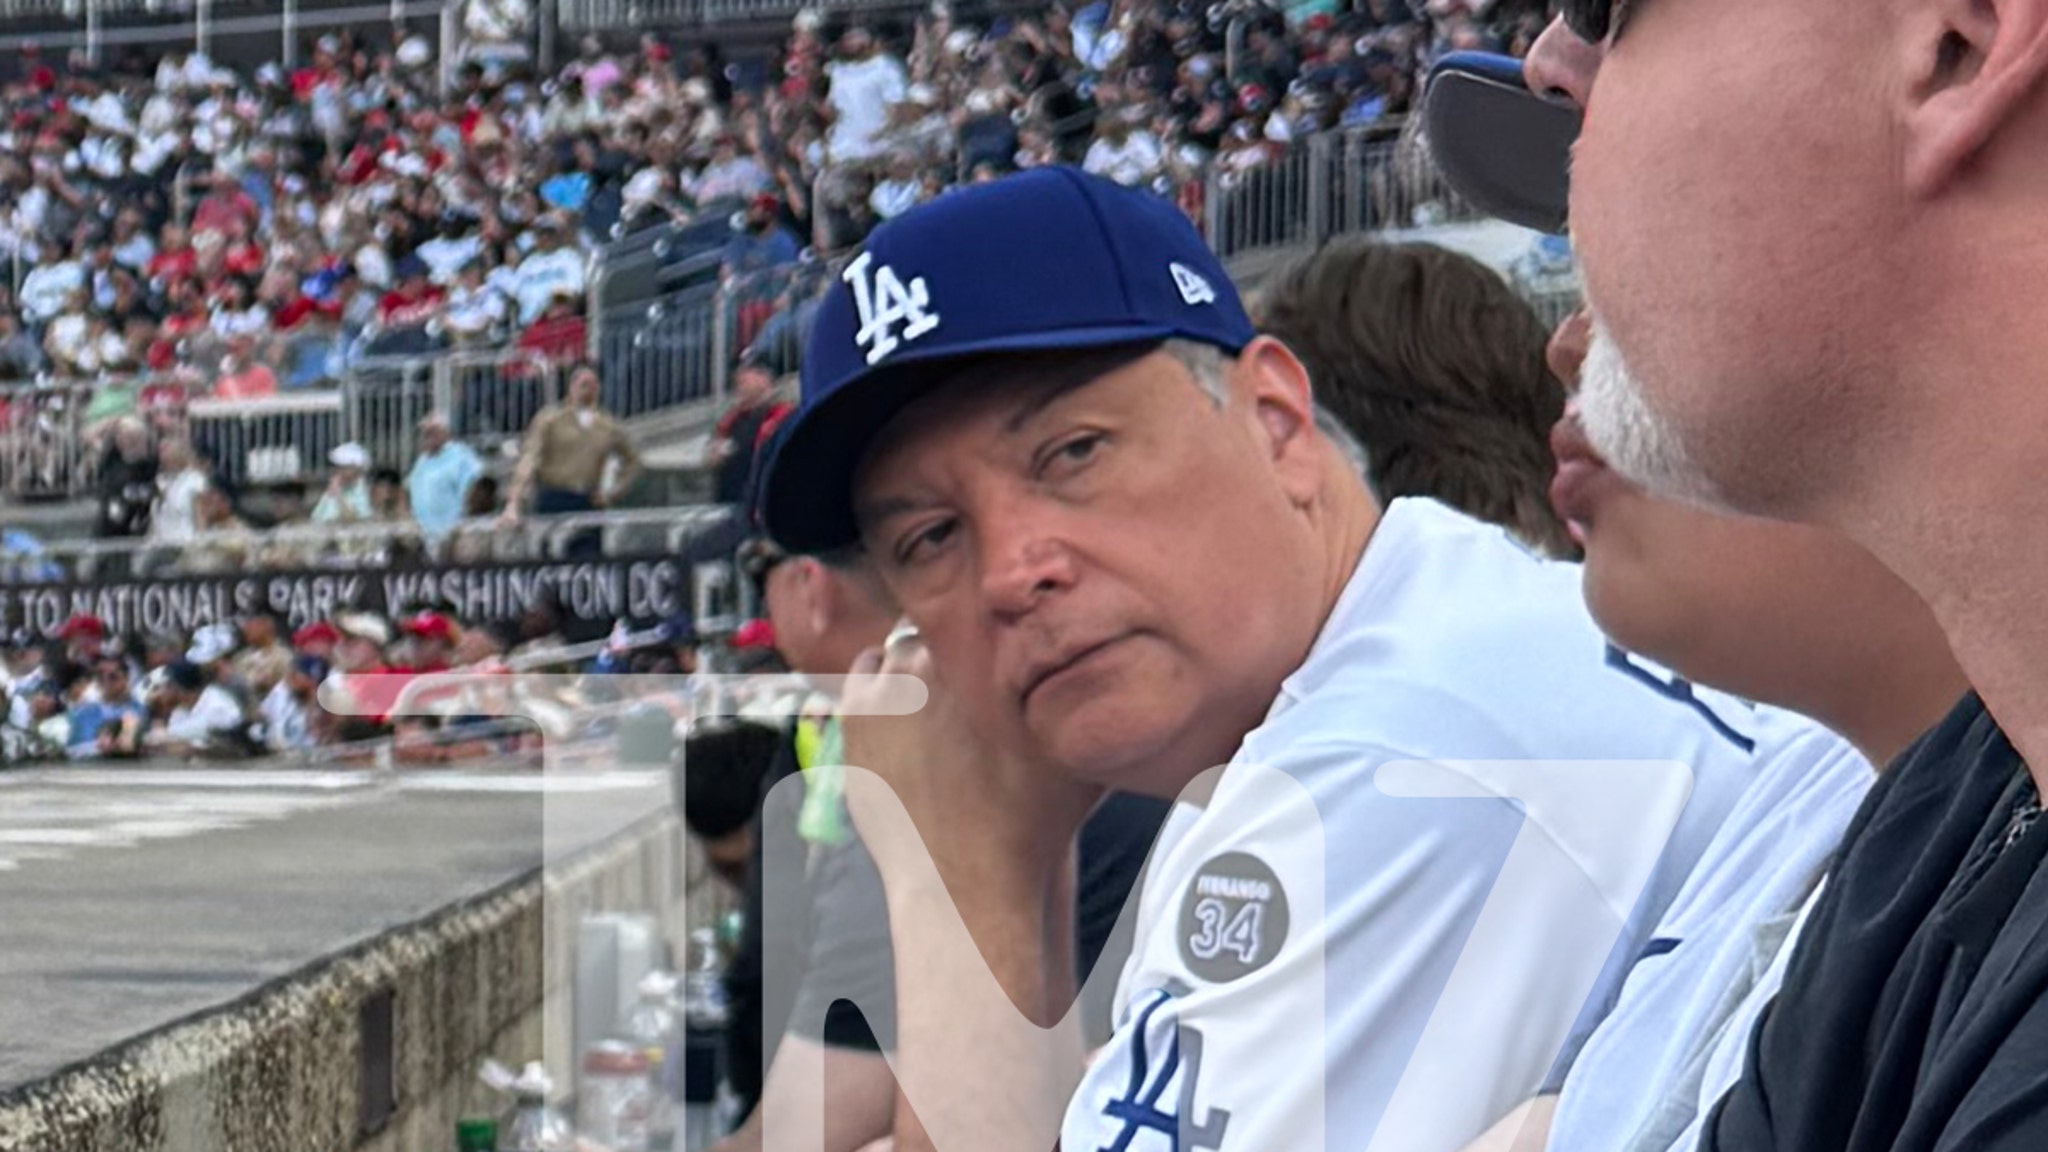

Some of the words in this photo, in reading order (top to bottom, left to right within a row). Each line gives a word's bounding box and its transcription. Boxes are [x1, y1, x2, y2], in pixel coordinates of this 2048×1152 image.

[843, 251, 939, 365] LA
[19, 587, 62, 639] TO
[268, 573, 359, 627] PARK
[628, 560, 677, 619] DC
[1189, 897, 1261, 964] 34
